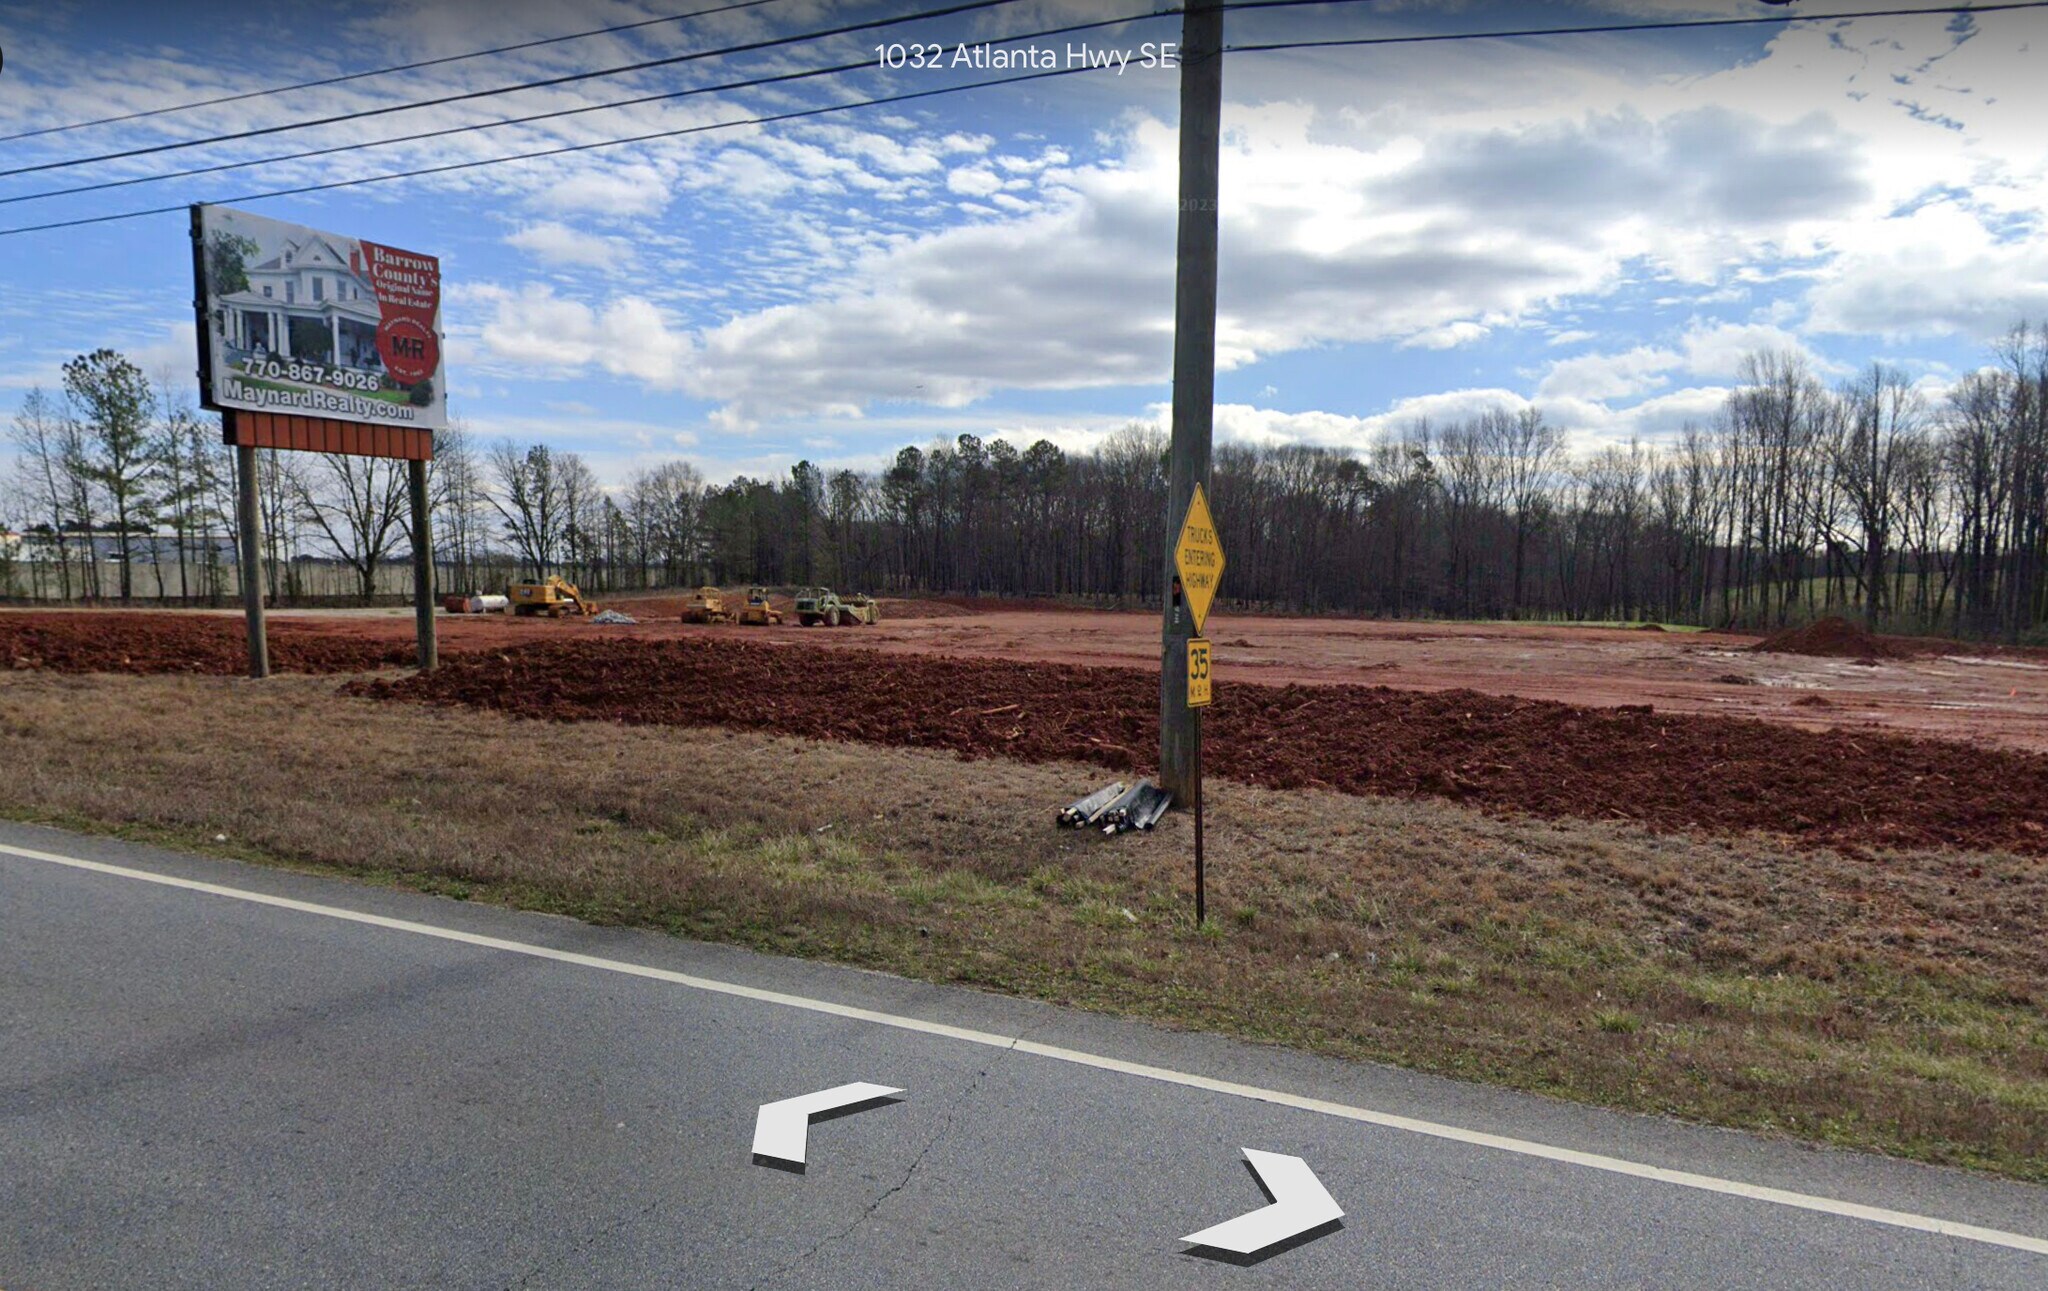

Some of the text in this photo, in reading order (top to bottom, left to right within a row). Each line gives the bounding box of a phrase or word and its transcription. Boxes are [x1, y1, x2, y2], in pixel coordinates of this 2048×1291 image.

[373, 246, 434, 272] Barrow
[372, 262, 438, 289] County's
[376, 279, 410, 293] Original
[388, 294, 407, 306] Real
[242, 357, 379, 392] 770-867-9026
[222, 378, 415, 420] MaynardRealty.com
[1187, 525, 1213, 545] TRUCKS
[1184, 548, 1215, 568] ENTERING
[1185, 571, 1214, 589] HIGHWAY
[1190, 648, 1209, 680] 35
